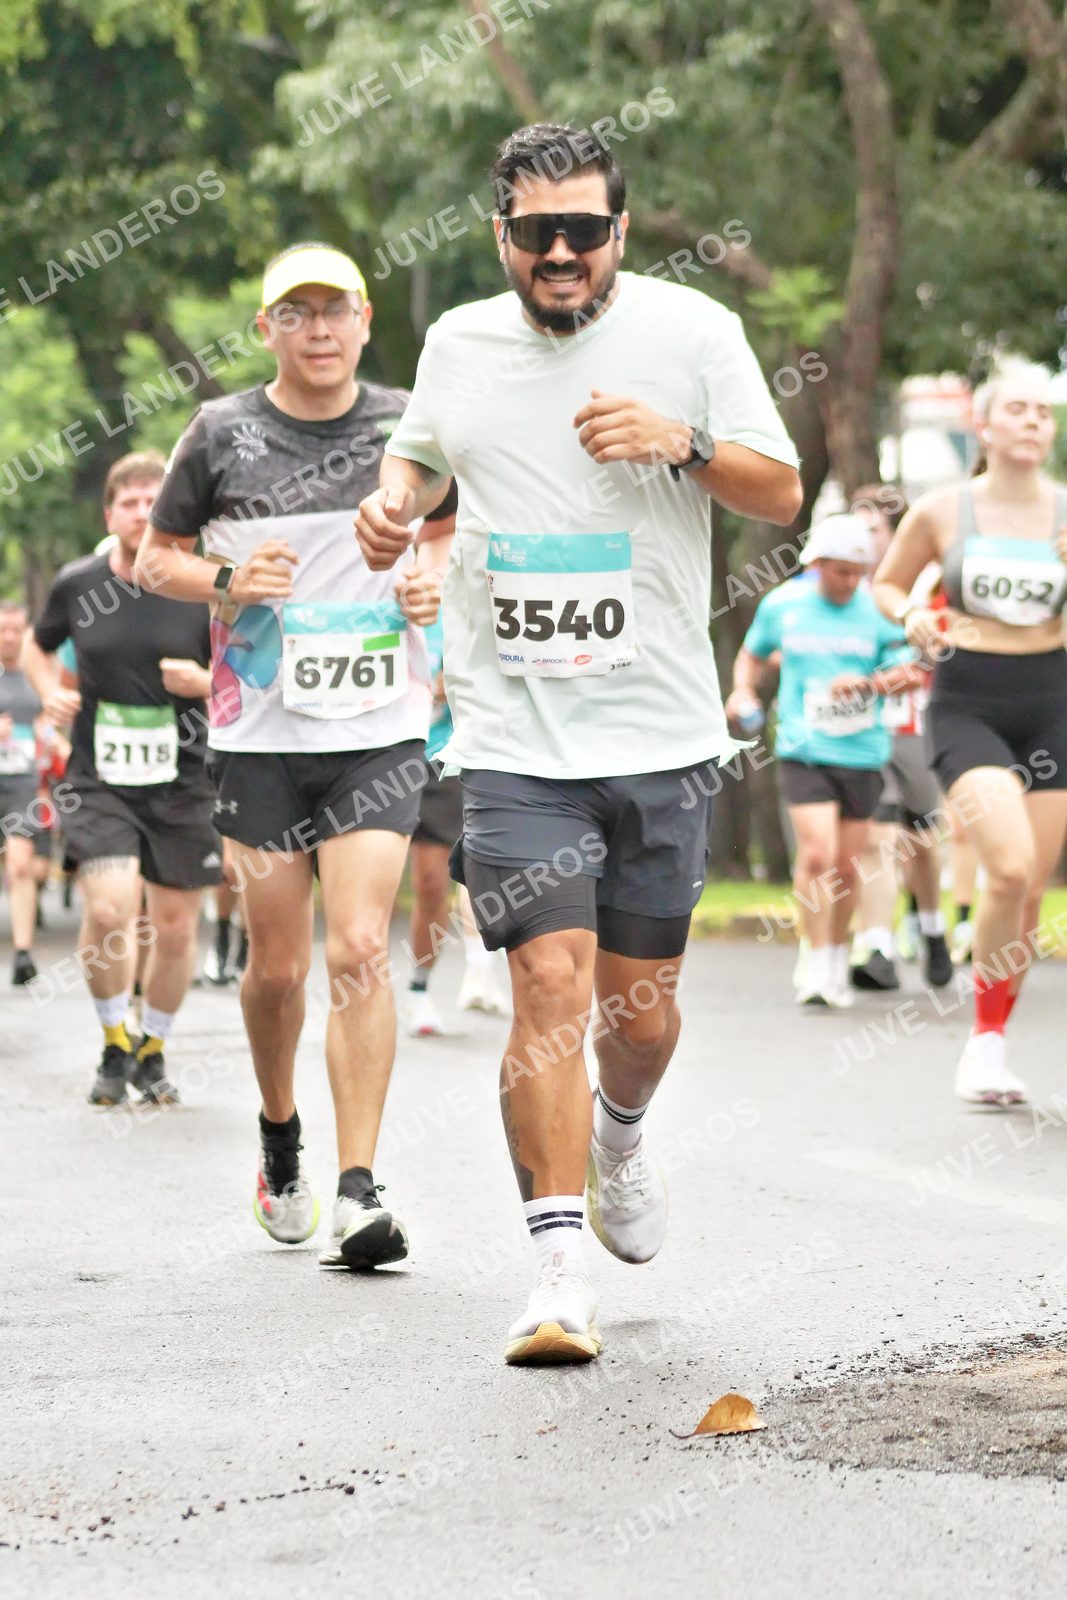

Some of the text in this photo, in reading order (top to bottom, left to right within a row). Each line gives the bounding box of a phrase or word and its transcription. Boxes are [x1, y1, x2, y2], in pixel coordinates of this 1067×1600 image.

[972, 574, 1054, 605] 6052
[494, 597, 625, 642] 3540
[295, 654, 394, 690] 6761
